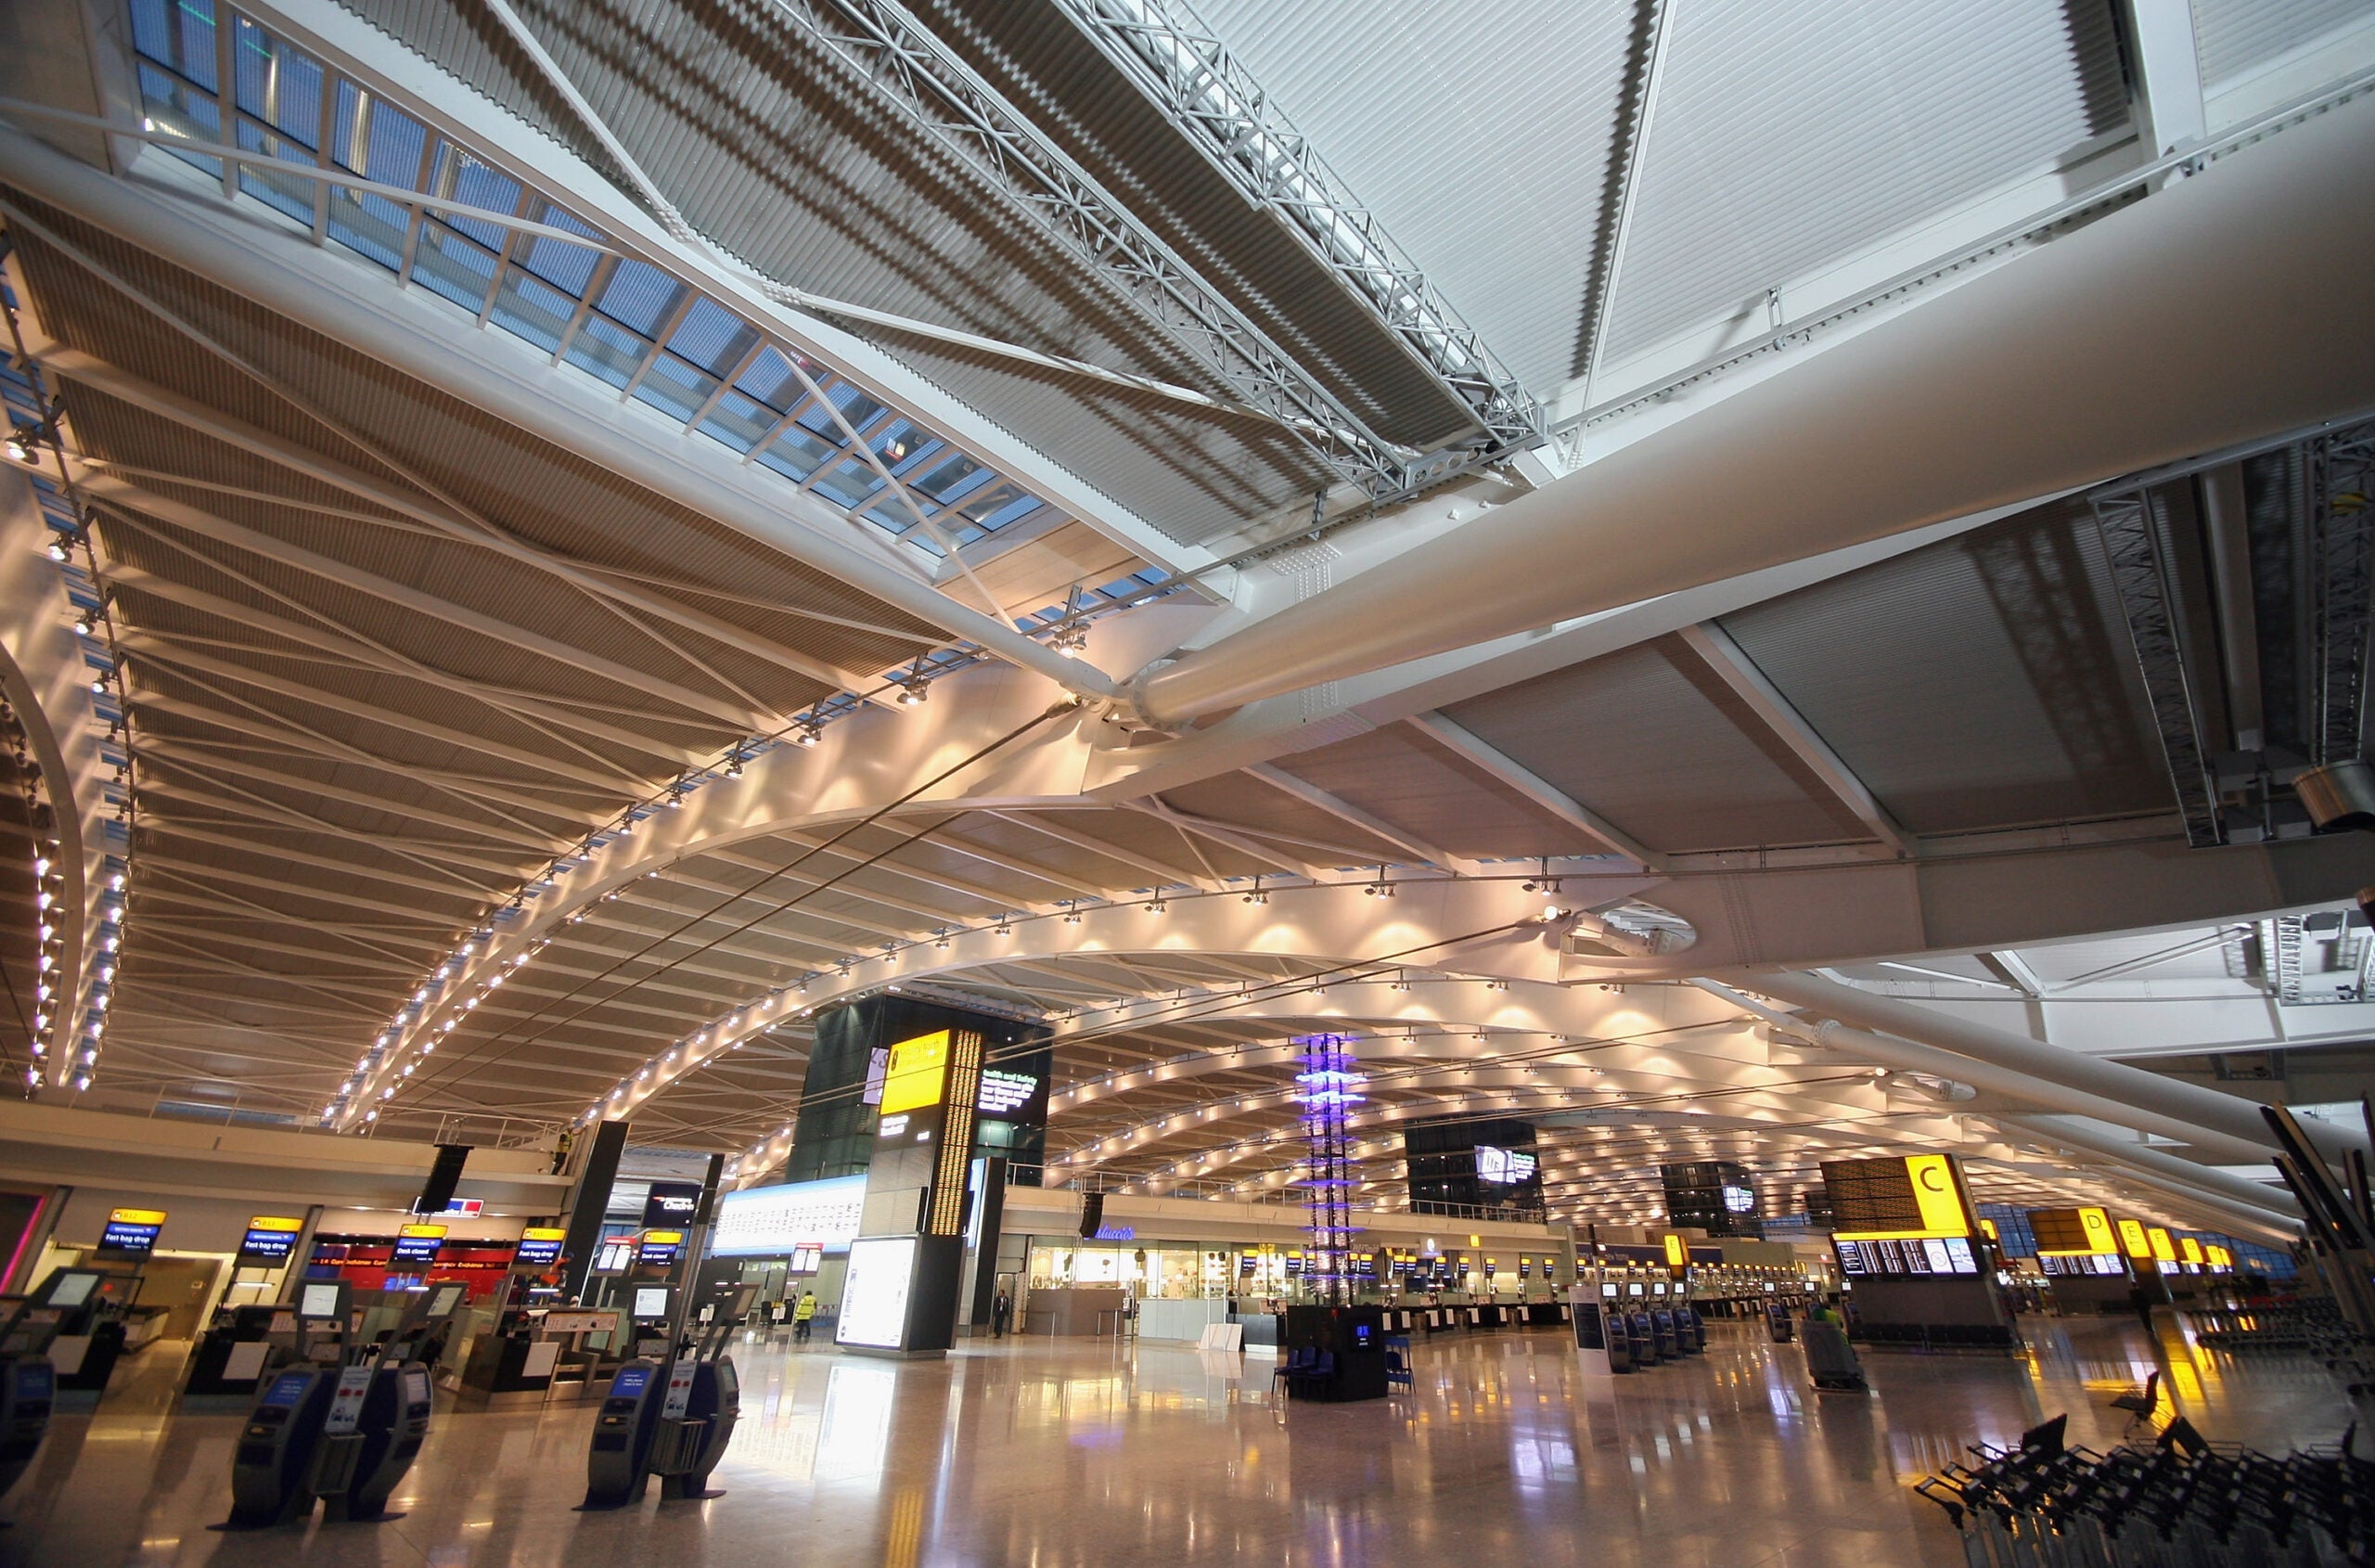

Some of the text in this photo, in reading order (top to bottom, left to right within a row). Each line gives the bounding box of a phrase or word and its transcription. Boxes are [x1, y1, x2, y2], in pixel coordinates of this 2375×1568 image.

[1919, 1165, 1944, 1192] C
[2086, 1215, 2102, 1229] D
[2126, 1226, 2138, 1237] E
[106, 1233, 150, 1244] Fast bag drop
[245, 1240, 288, 1251] Fast bag drop
